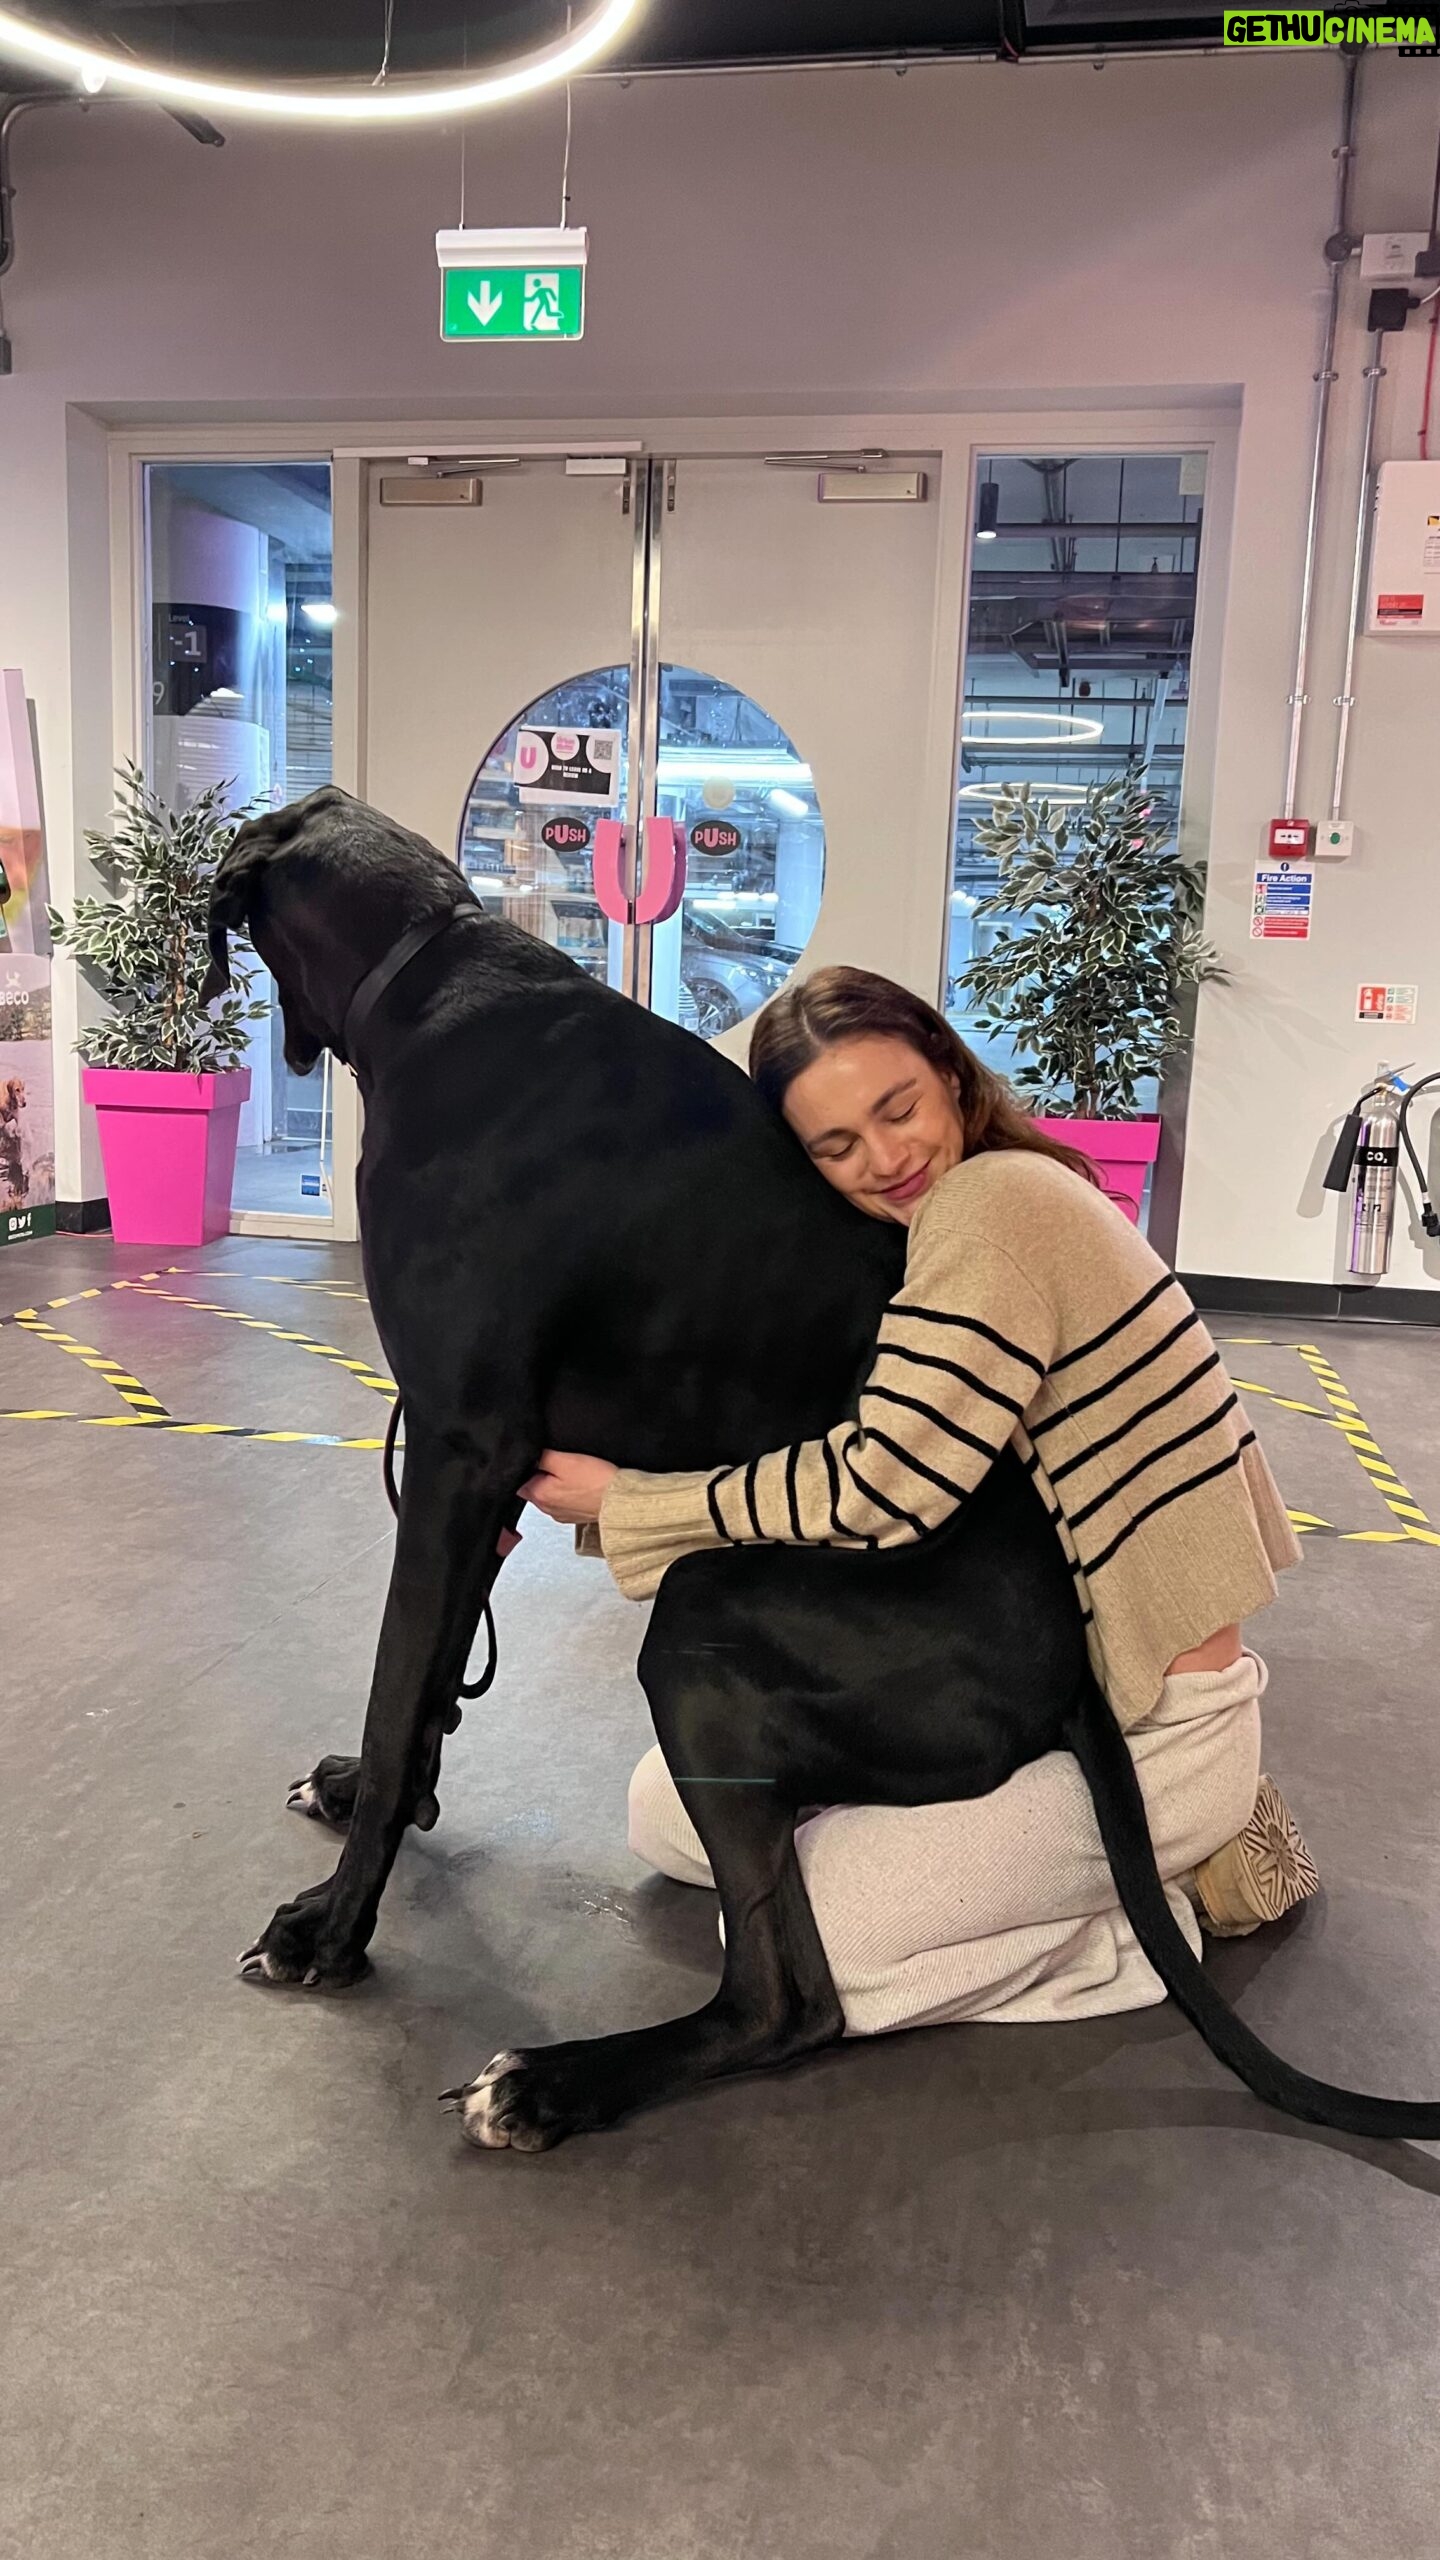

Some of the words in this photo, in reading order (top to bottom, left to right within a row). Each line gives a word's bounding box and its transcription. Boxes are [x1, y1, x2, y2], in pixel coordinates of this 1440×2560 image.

[520, 746, 537, 769] U
[545, 824, 587, 845] PUSH
[694, 827, 737, 848] PUSH
[1261, 874, 1279, 882] Fire
[1279, 874, 1308, 883] Action
